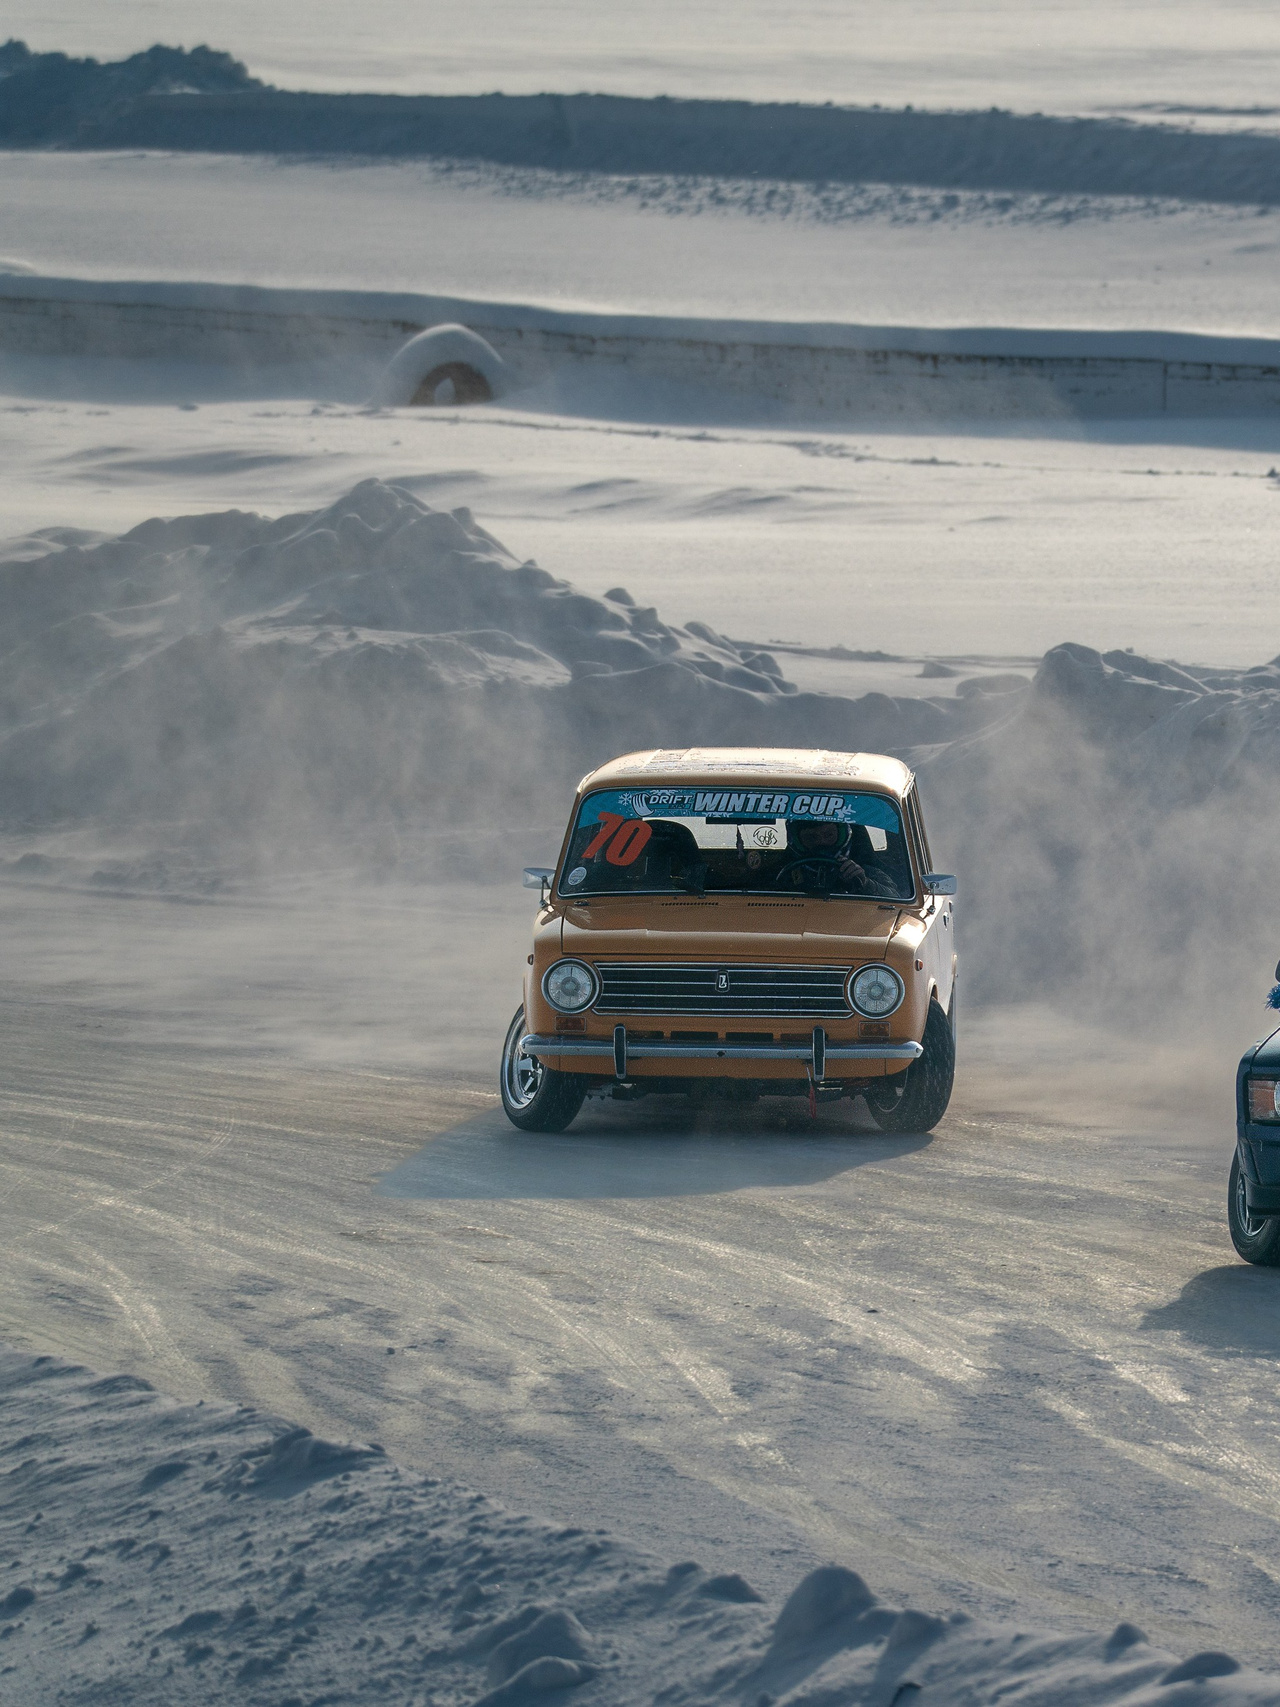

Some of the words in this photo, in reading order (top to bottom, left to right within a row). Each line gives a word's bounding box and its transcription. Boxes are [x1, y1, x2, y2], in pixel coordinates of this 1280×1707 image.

[649, 795, 693, 804] DRIFT
[694, 792, 790, 813] WINTER
[792, 795, 844, 816] CUP
[581, 812, 653, 866] 70
